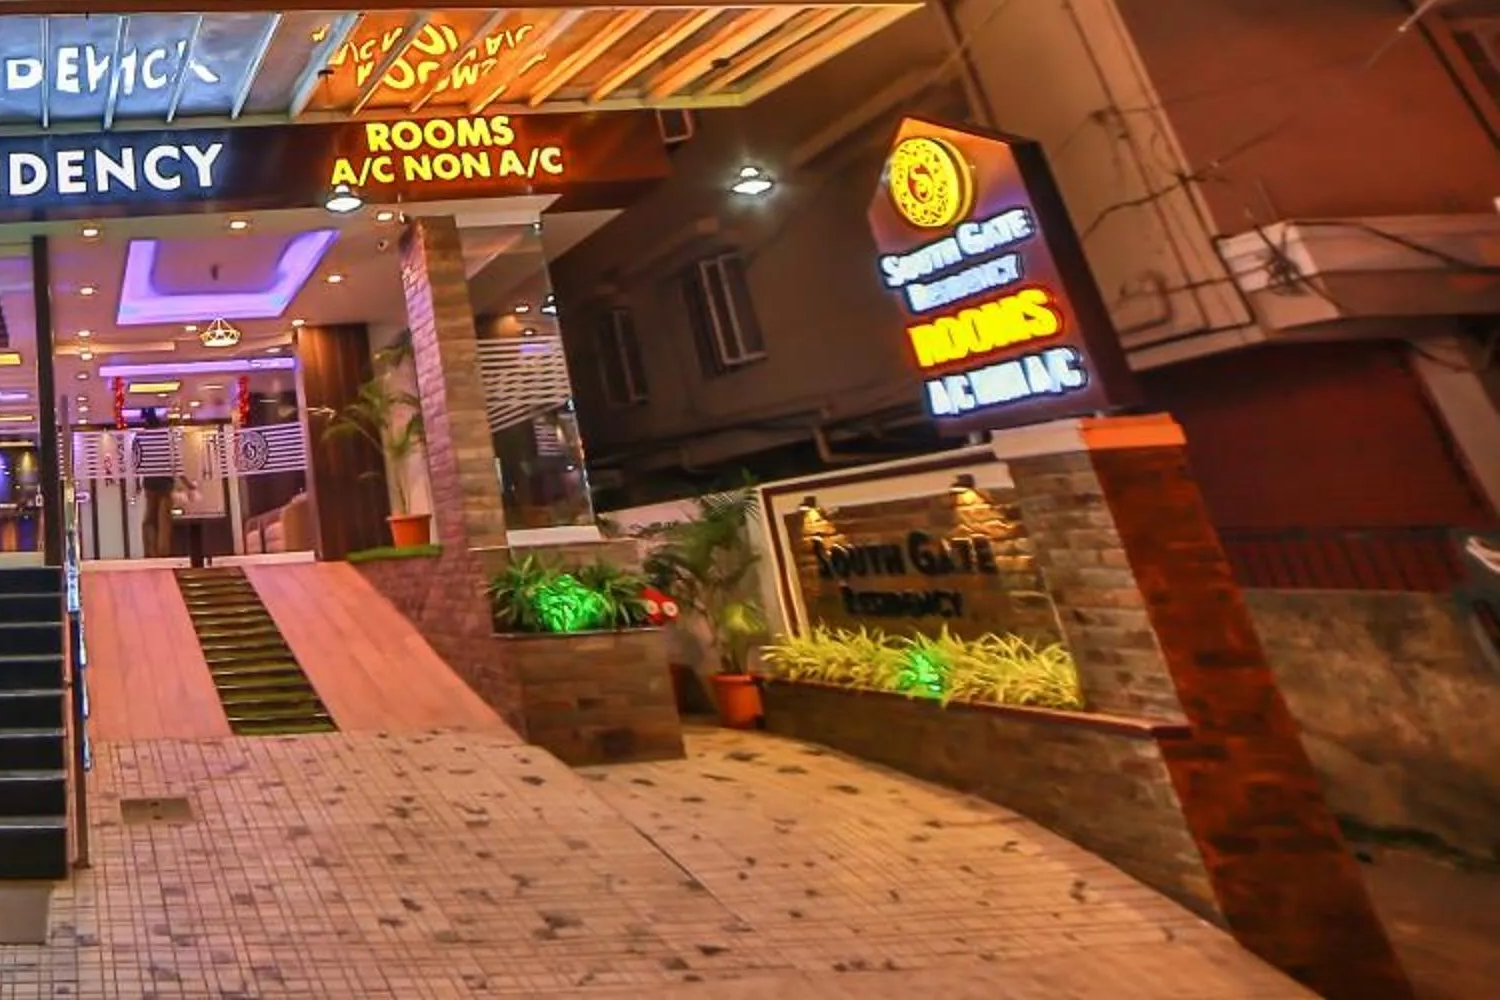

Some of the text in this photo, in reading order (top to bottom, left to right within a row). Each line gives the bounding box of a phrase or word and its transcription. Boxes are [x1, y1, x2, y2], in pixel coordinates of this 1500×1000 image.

[365, 116, 515, 152] ROOMS
[331, 147, 564, 187] A/C NON A/C
